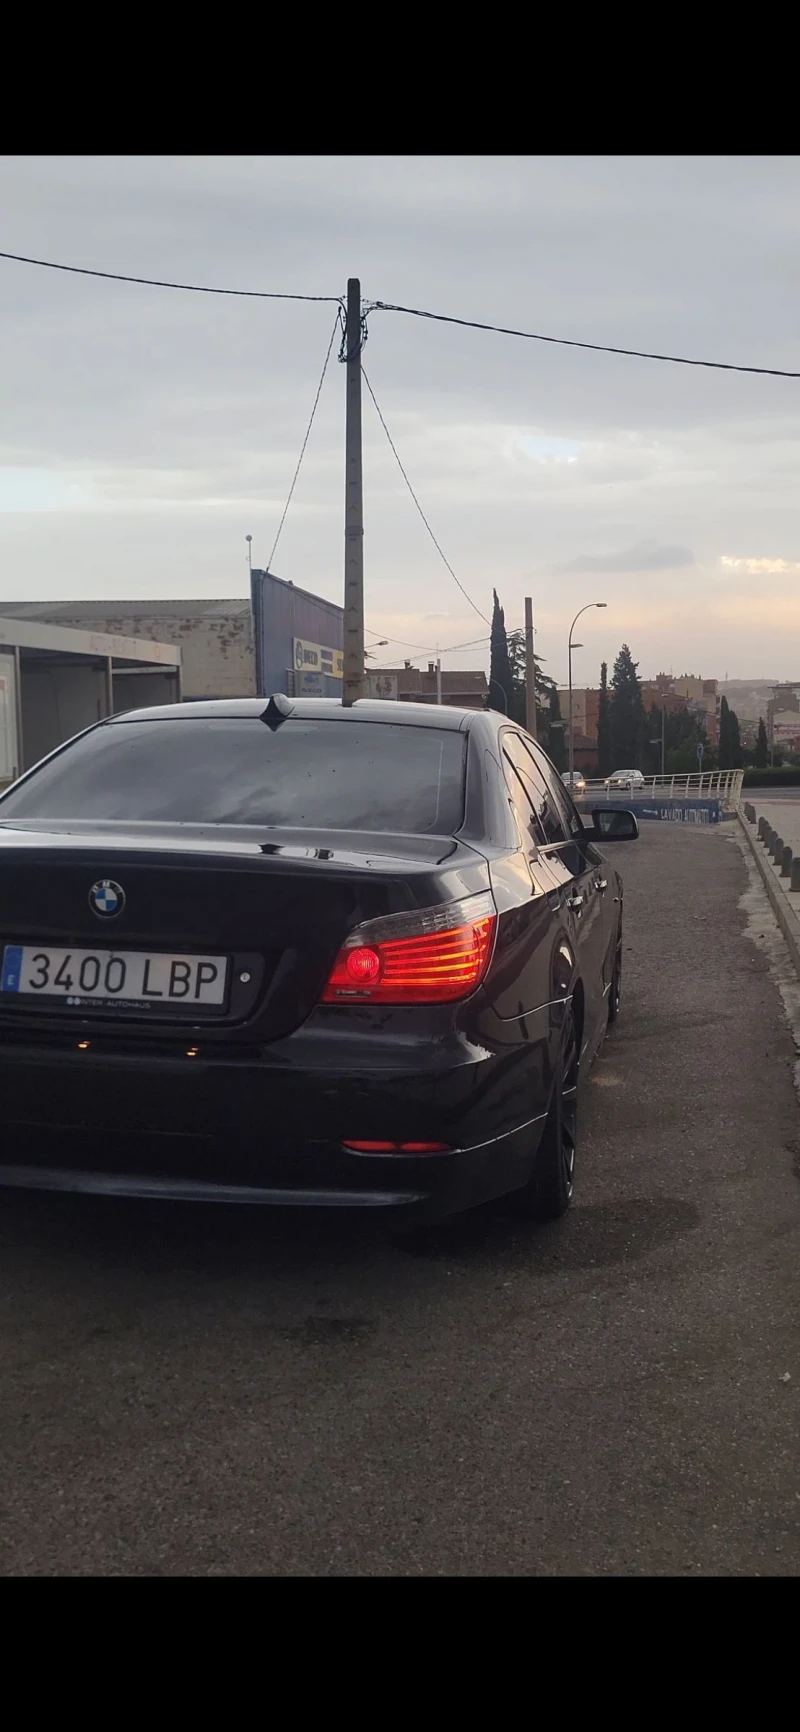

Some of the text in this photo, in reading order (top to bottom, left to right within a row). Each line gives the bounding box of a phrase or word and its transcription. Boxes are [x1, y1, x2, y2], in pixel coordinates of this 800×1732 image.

[7, 974, 15, 986] E
[28, 953, 218, 1000] 3400 LBP
